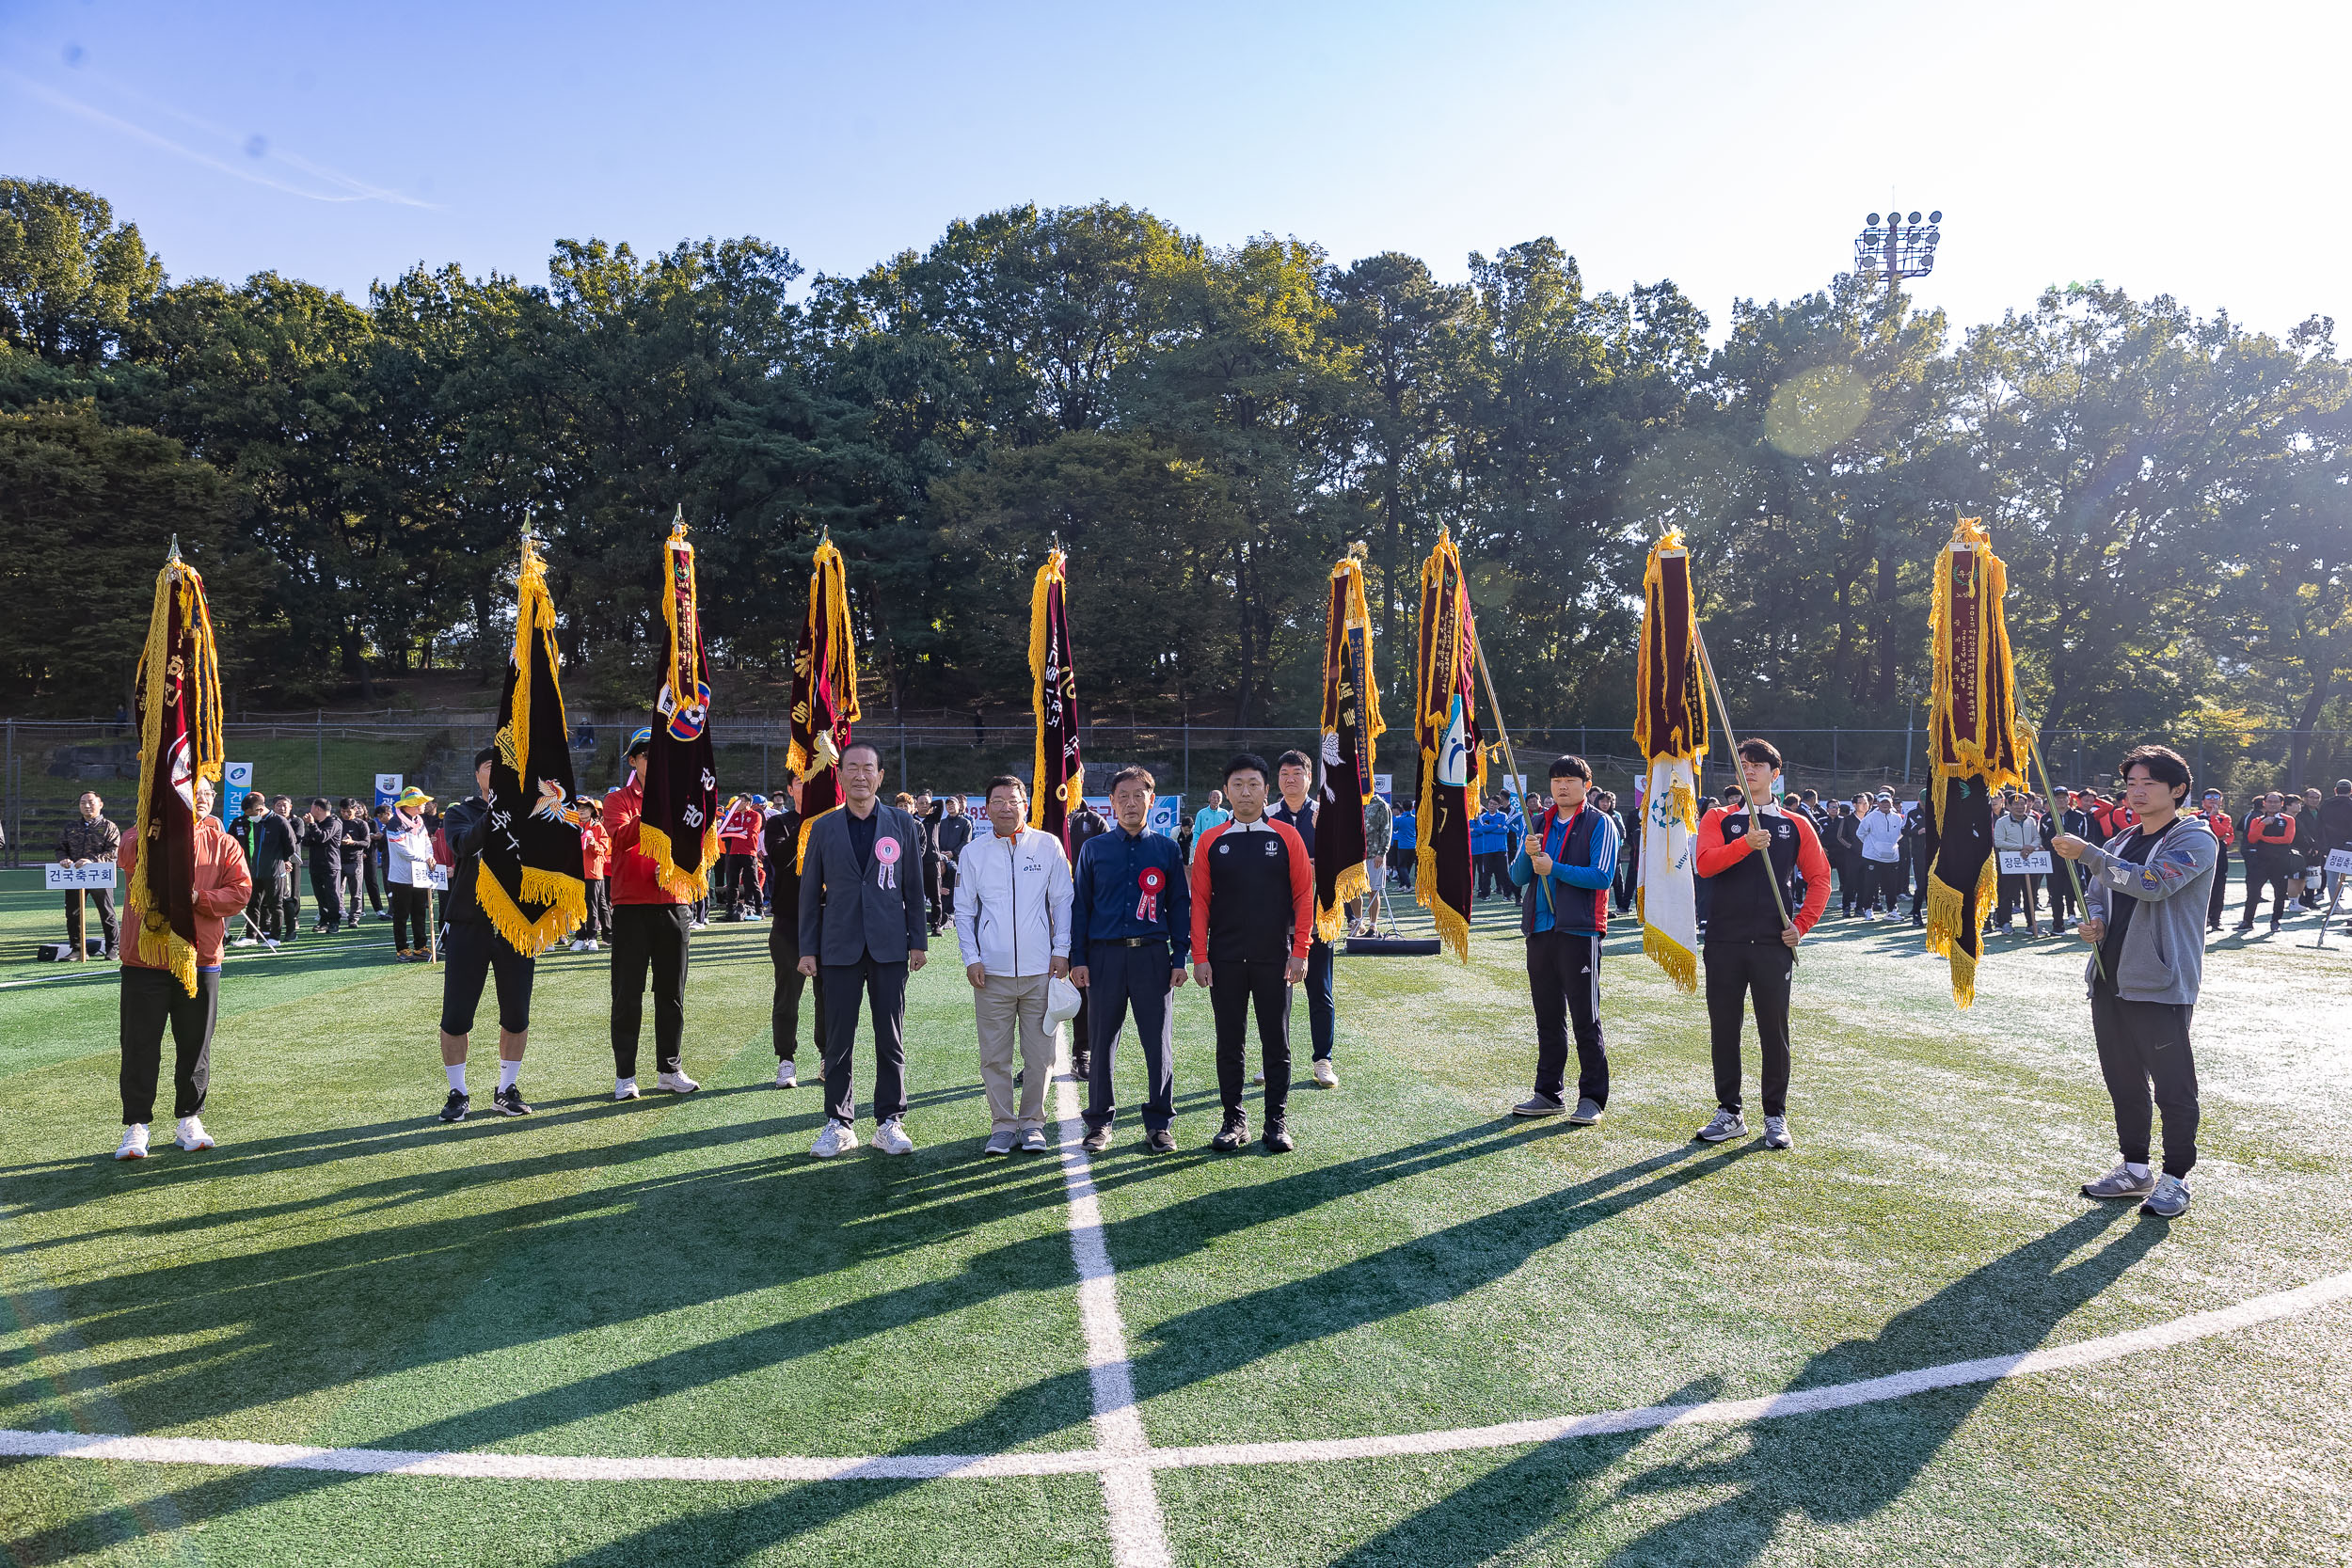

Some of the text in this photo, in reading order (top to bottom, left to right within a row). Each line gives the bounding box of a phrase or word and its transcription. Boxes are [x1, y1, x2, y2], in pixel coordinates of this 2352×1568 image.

[2005, 857, 2047, 868] 장문축구회
[2329, 856, 2352, 869] 정립축
[50, 868, 111, 882] 건국축구회
